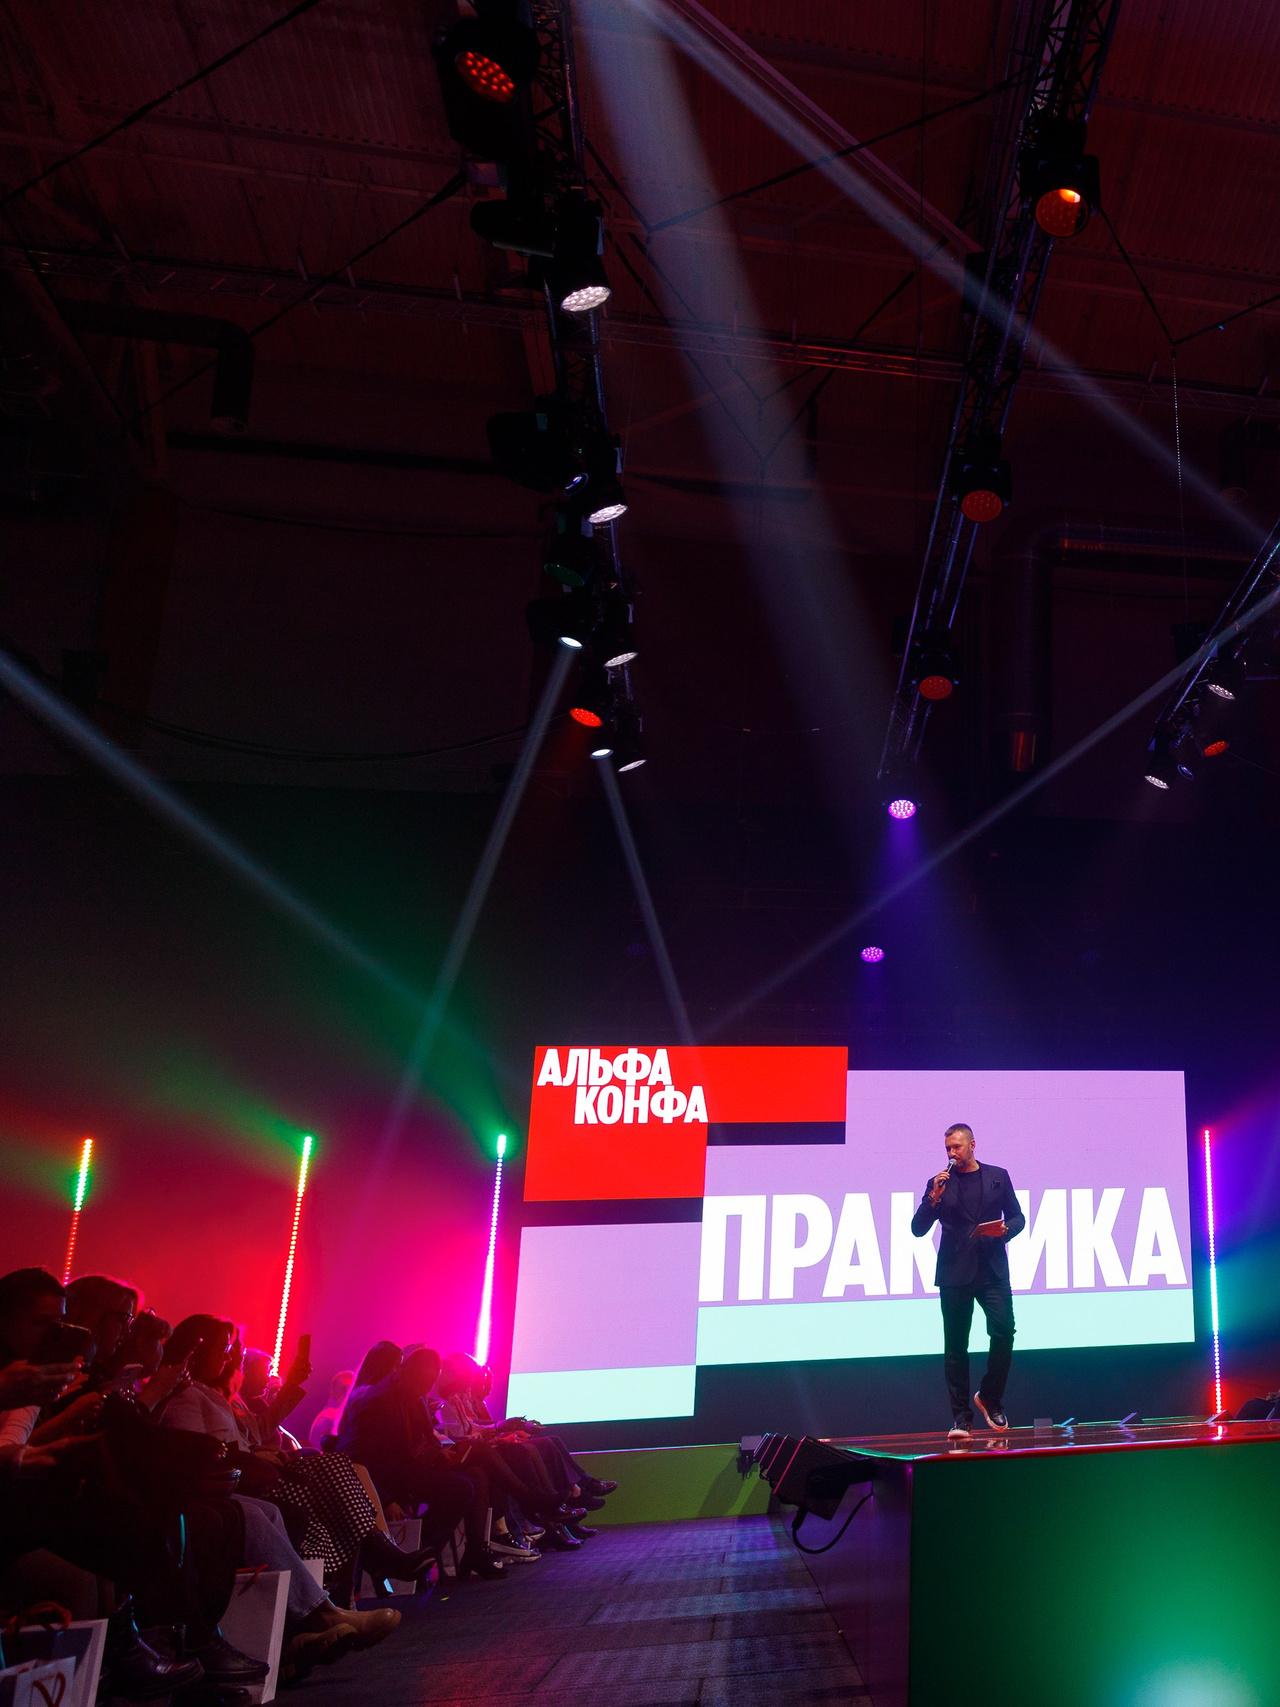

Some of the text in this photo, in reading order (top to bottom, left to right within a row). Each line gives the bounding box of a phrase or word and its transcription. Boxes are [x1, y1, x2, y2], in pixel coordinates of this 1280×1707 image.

[537, 1048, 673, 1086] АЛЬФА
[574, 1085, 709, 1125] КОНФА
[700, 1186, 1188, 1303] ПРАКИКА
